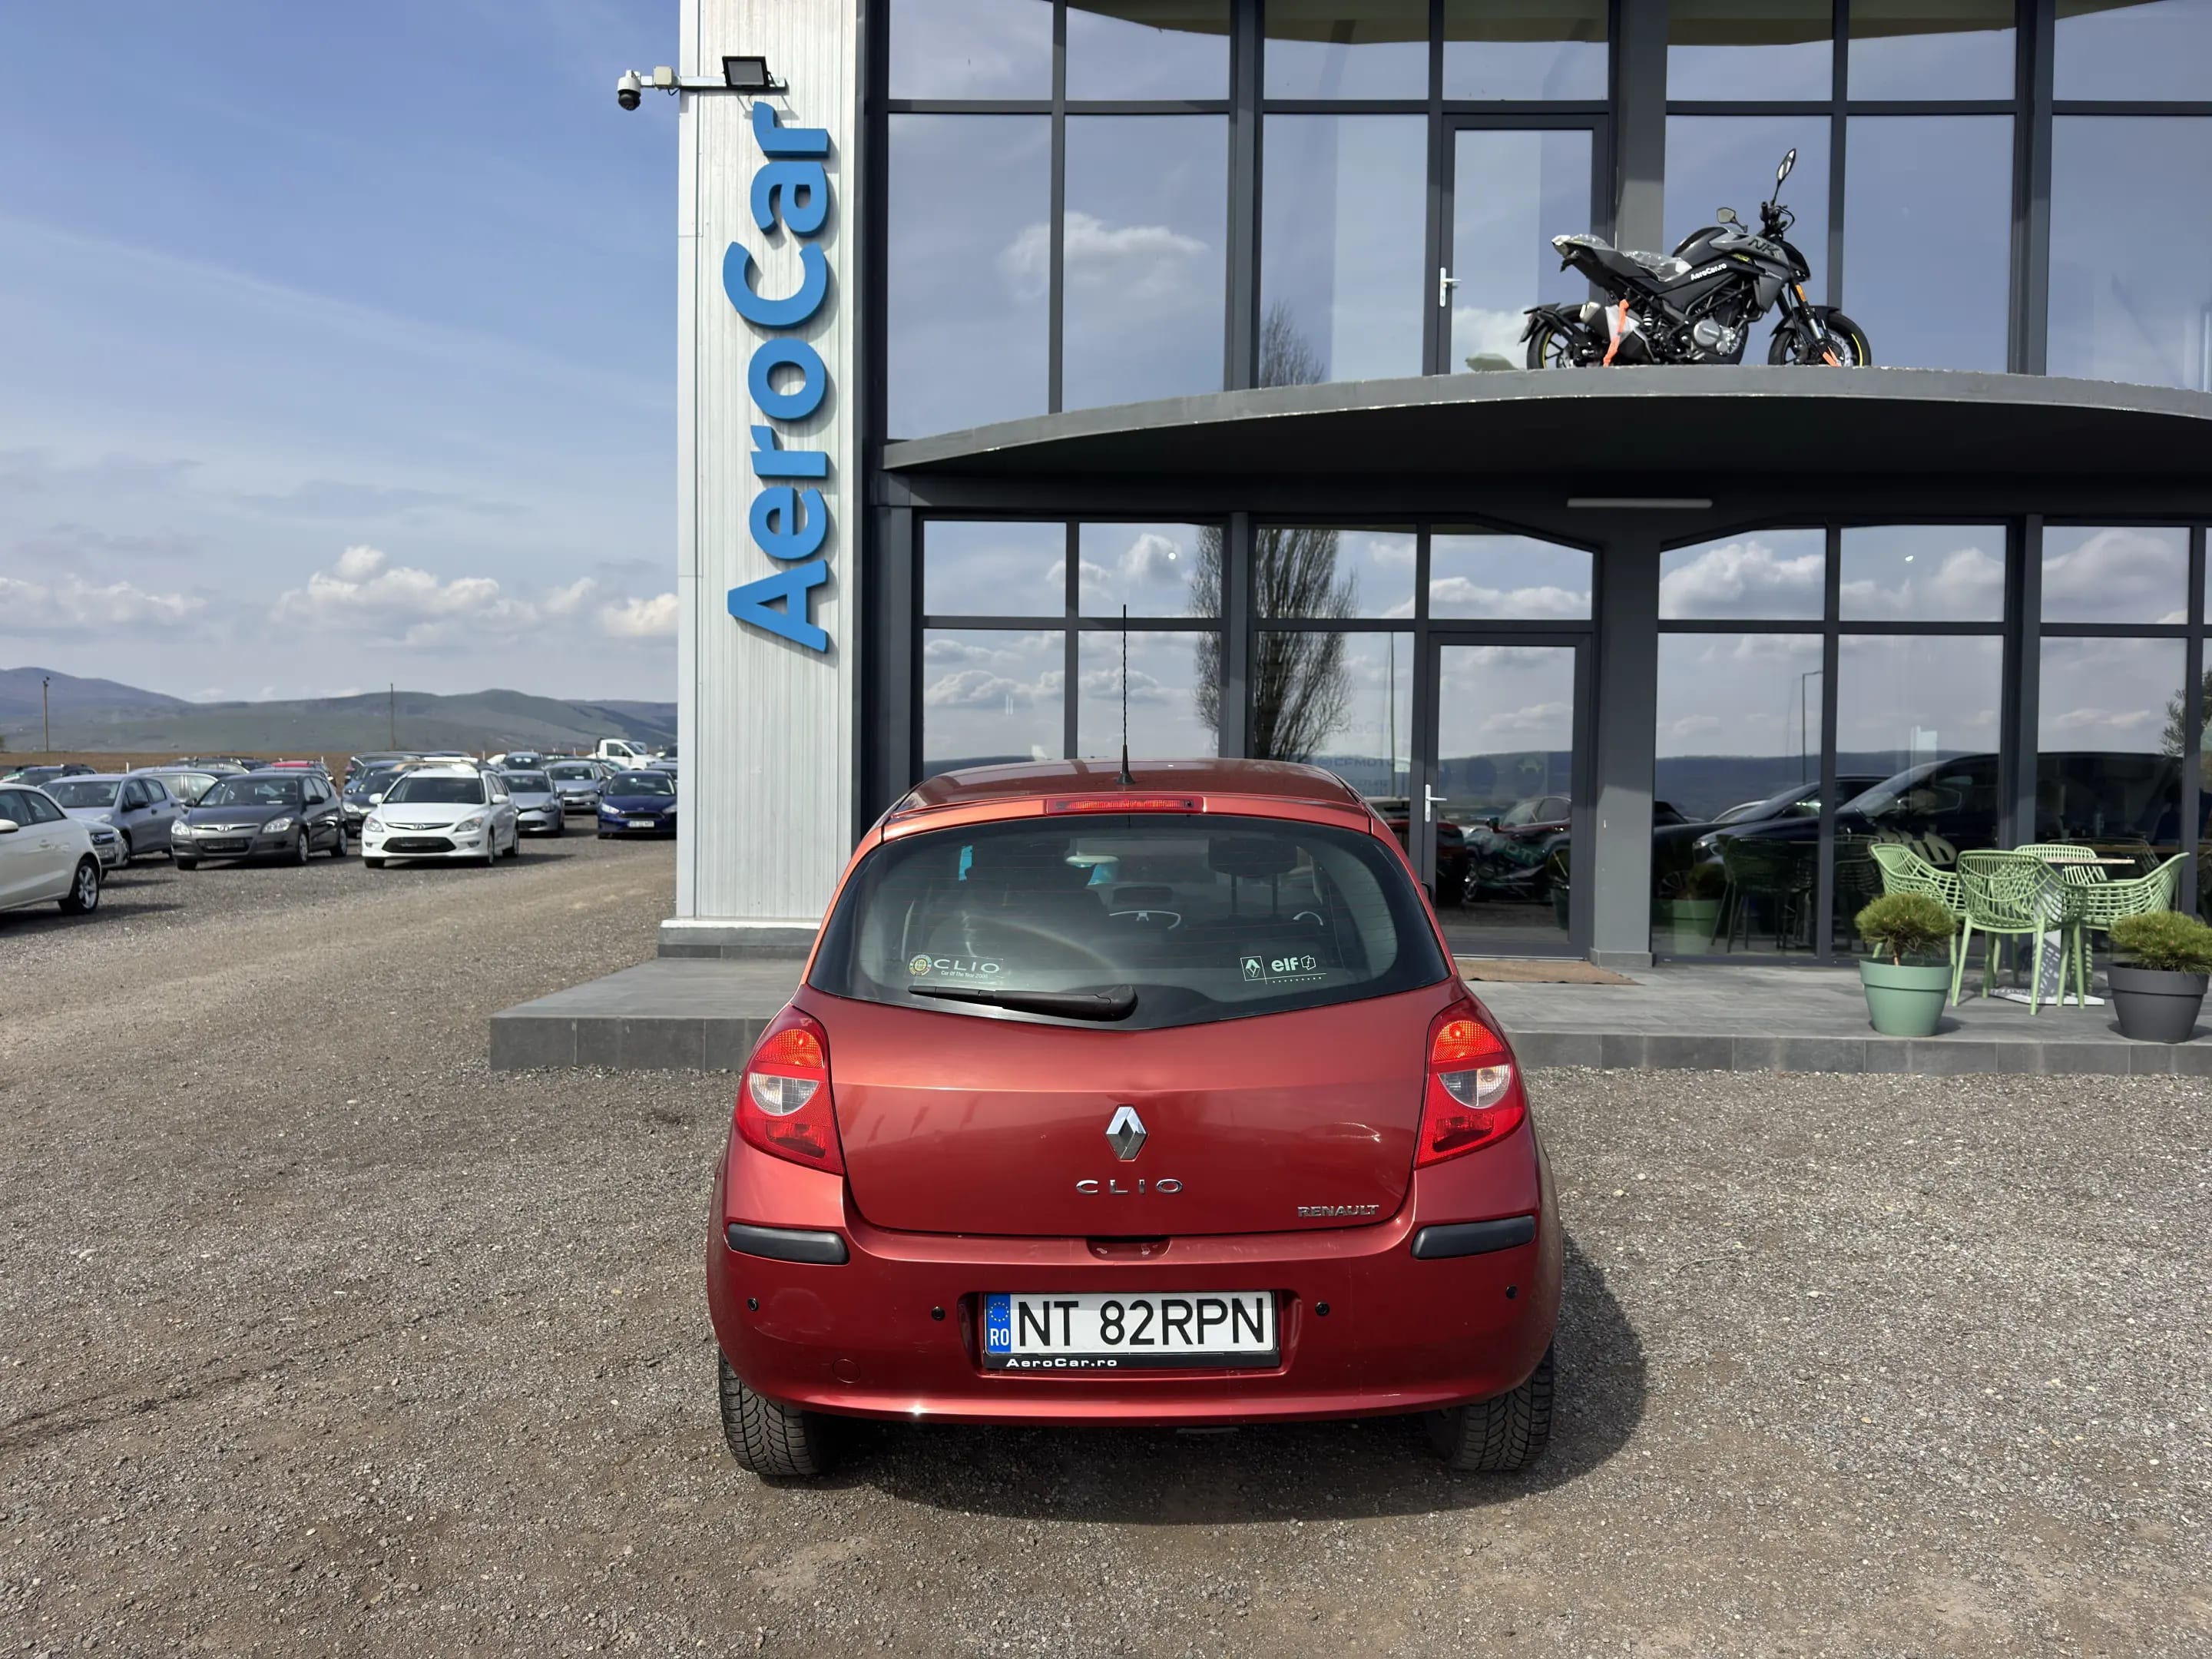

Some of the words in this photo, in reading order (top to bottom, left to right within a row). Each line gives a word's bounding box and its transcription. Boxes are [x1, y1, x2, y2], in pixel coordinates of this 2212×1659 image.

[723, 101, 830, 654] AeroCar
[933, 959, 1000, 974] CLIO
[1271, 956, 1299, 972] elf
[1075, 1178, 1184, 1195] CLIO
[1297, 1204, 1380, 1217] RENAULT
[1018, 1300, 1079, 1347] NT
[1099, 1297, 1264, 1346] 82RPN
[990, 1328, 1010, 1346] RO
[1005, 1357, 1118, 1368] AeroCar.ro
